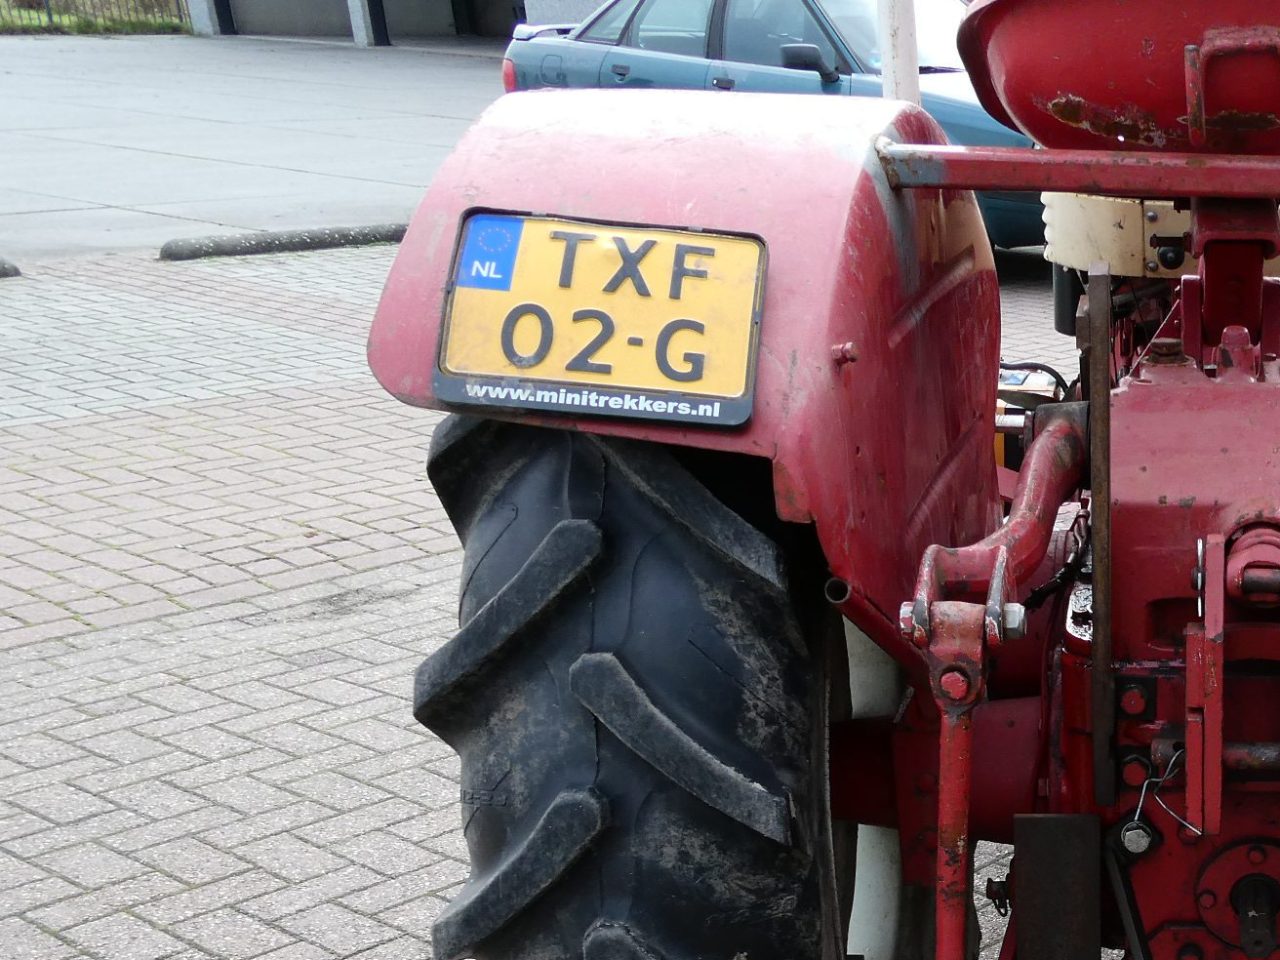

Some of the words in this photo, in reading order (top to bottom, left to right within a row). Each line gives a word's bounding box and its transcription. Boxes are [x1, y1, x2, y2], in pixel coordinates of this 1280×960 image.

[471, 260, 503, 279] NL
[550, 231, 716, 300] TXF
[500, 303, 706, 383] 02-G
[465, 383, 721, 418] www.minitrekkers.nl
